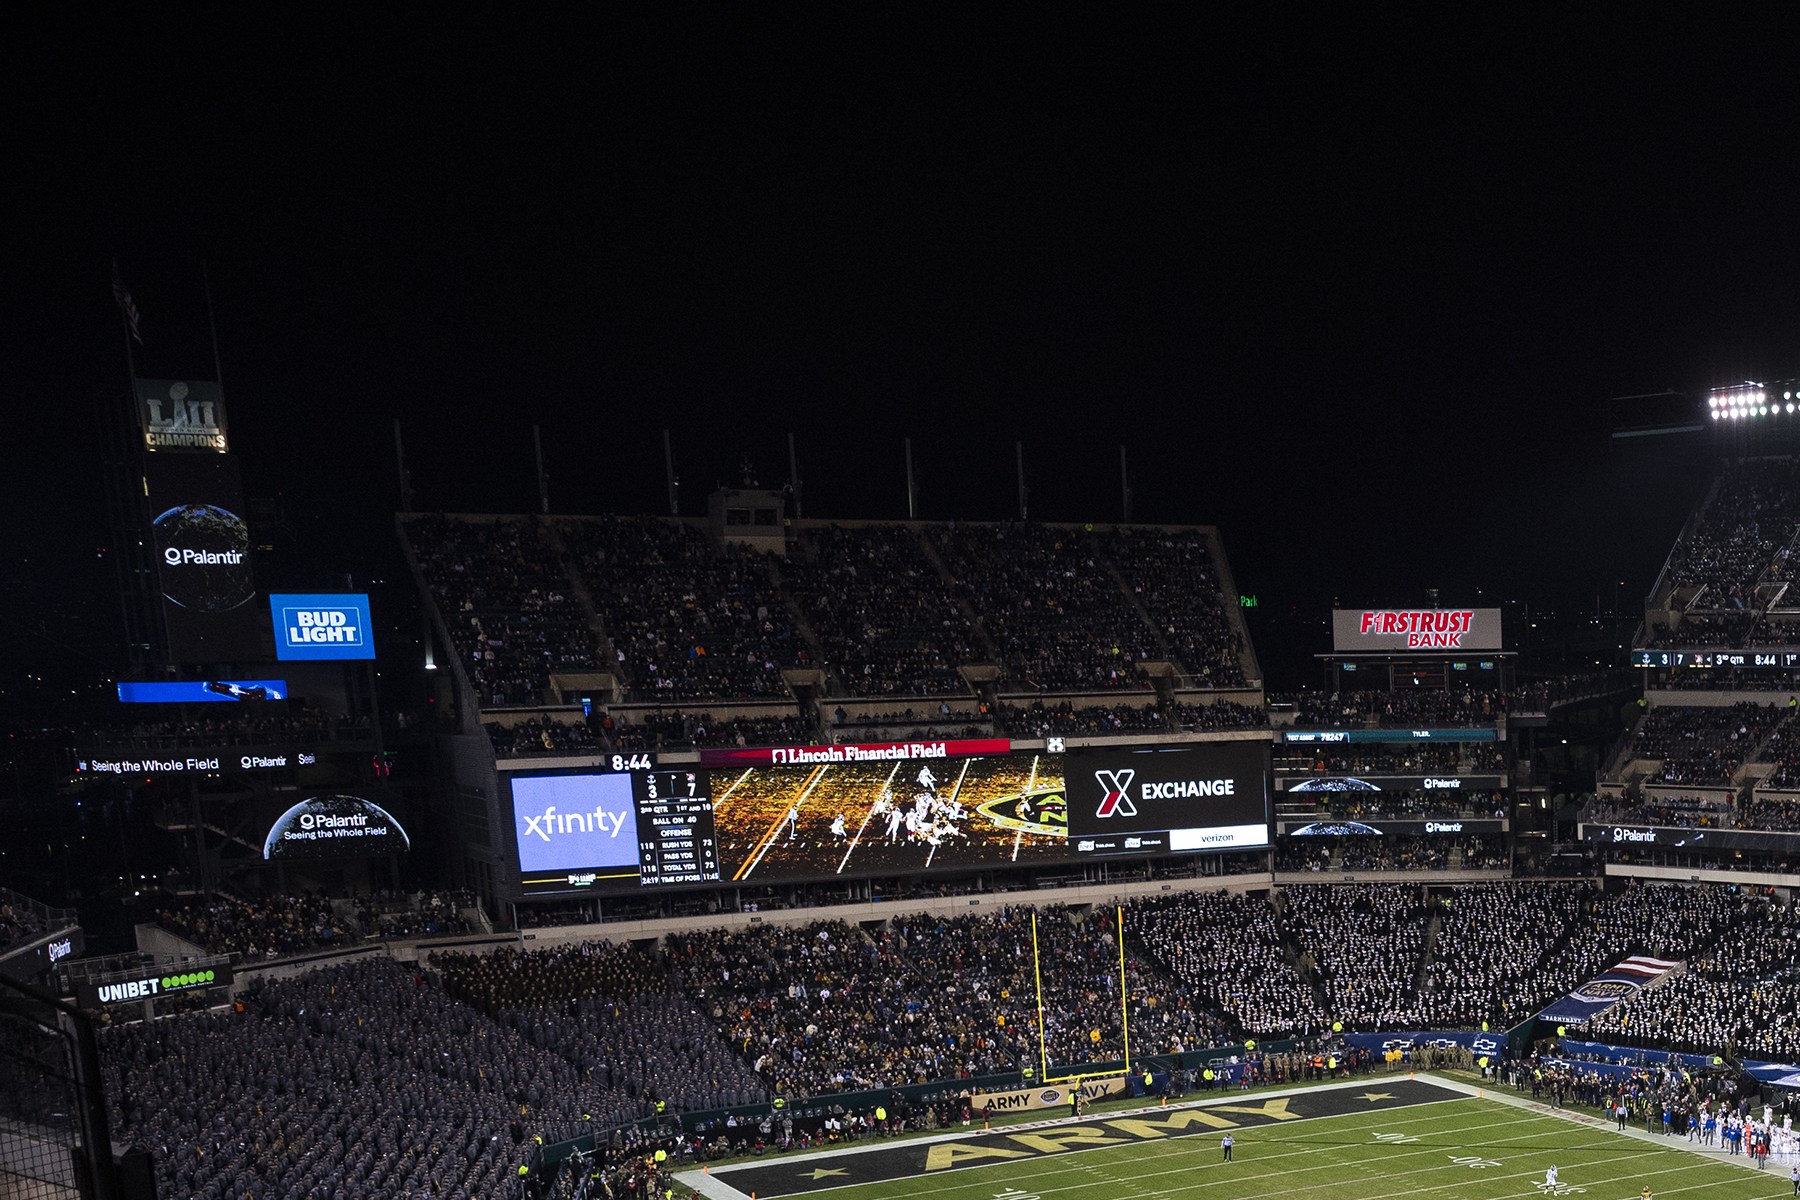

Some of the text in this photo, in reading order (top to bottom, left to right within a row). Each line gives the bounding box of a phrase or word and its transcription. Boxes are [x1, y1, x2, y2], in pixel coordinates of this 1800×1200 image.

[146, 433, 226, 448] CHAMPIONS
[183, 549, 243, 565] Palantir
[1240, 596, 1258, 607] Park
[297, 611, 346, 627] BUD
[290, 626, 356, 642] LIGHT
[1408, 633, 1461, 648] BANK
[1662, 654, 1668, 664] 3
[1677, 654, 1684, 665] 7
[1716, 654, 1744, 665] 3RD QTR
[1755, 654, 1776, 666] 8:44
[1786, 654, 1796, 666] 1ST
[1320, 732, 1344, 742] 78247
[788, 743, 946, 763] Lincoln Financial Field
[92, 760, 120, 774] Seeing
[122, 760, 140, 772] the
[141, 760, 184, 772] Whole
[186, 758, 219, 770] Field
[252, 756, 287, 768] Palantir
[612, 754, 652, 770] 8:44
[687, 783, 696, 796] 7
[1142, 779, 1234, 800] EXCHANGE
[1432, 779, 1461, 788] Palantir
[648, 785, 658, 798] 3
[316, 814, 368, 828] Palantir
[524, 806, 627, 841] xfinity
[1433, 822, 1462, 832] Palantir
[284, 826, 388, 841] Seeing the Whole Field
[660, 828, 692, 836] OFFENSE
[1201, 833, 1234, 842] verizon
[1623, 830, 1656, 842] Palantir
[640, 842, 654, 850] 118
[663, 864, 682, 872] TOTAL
[54, 940, 71, 960] Palantir
[98, 978, 160, 1002] UNIBET
[986, 1094, 1030, 1110] ARMY
[924, 1098, 1303, 1172] ARMY
